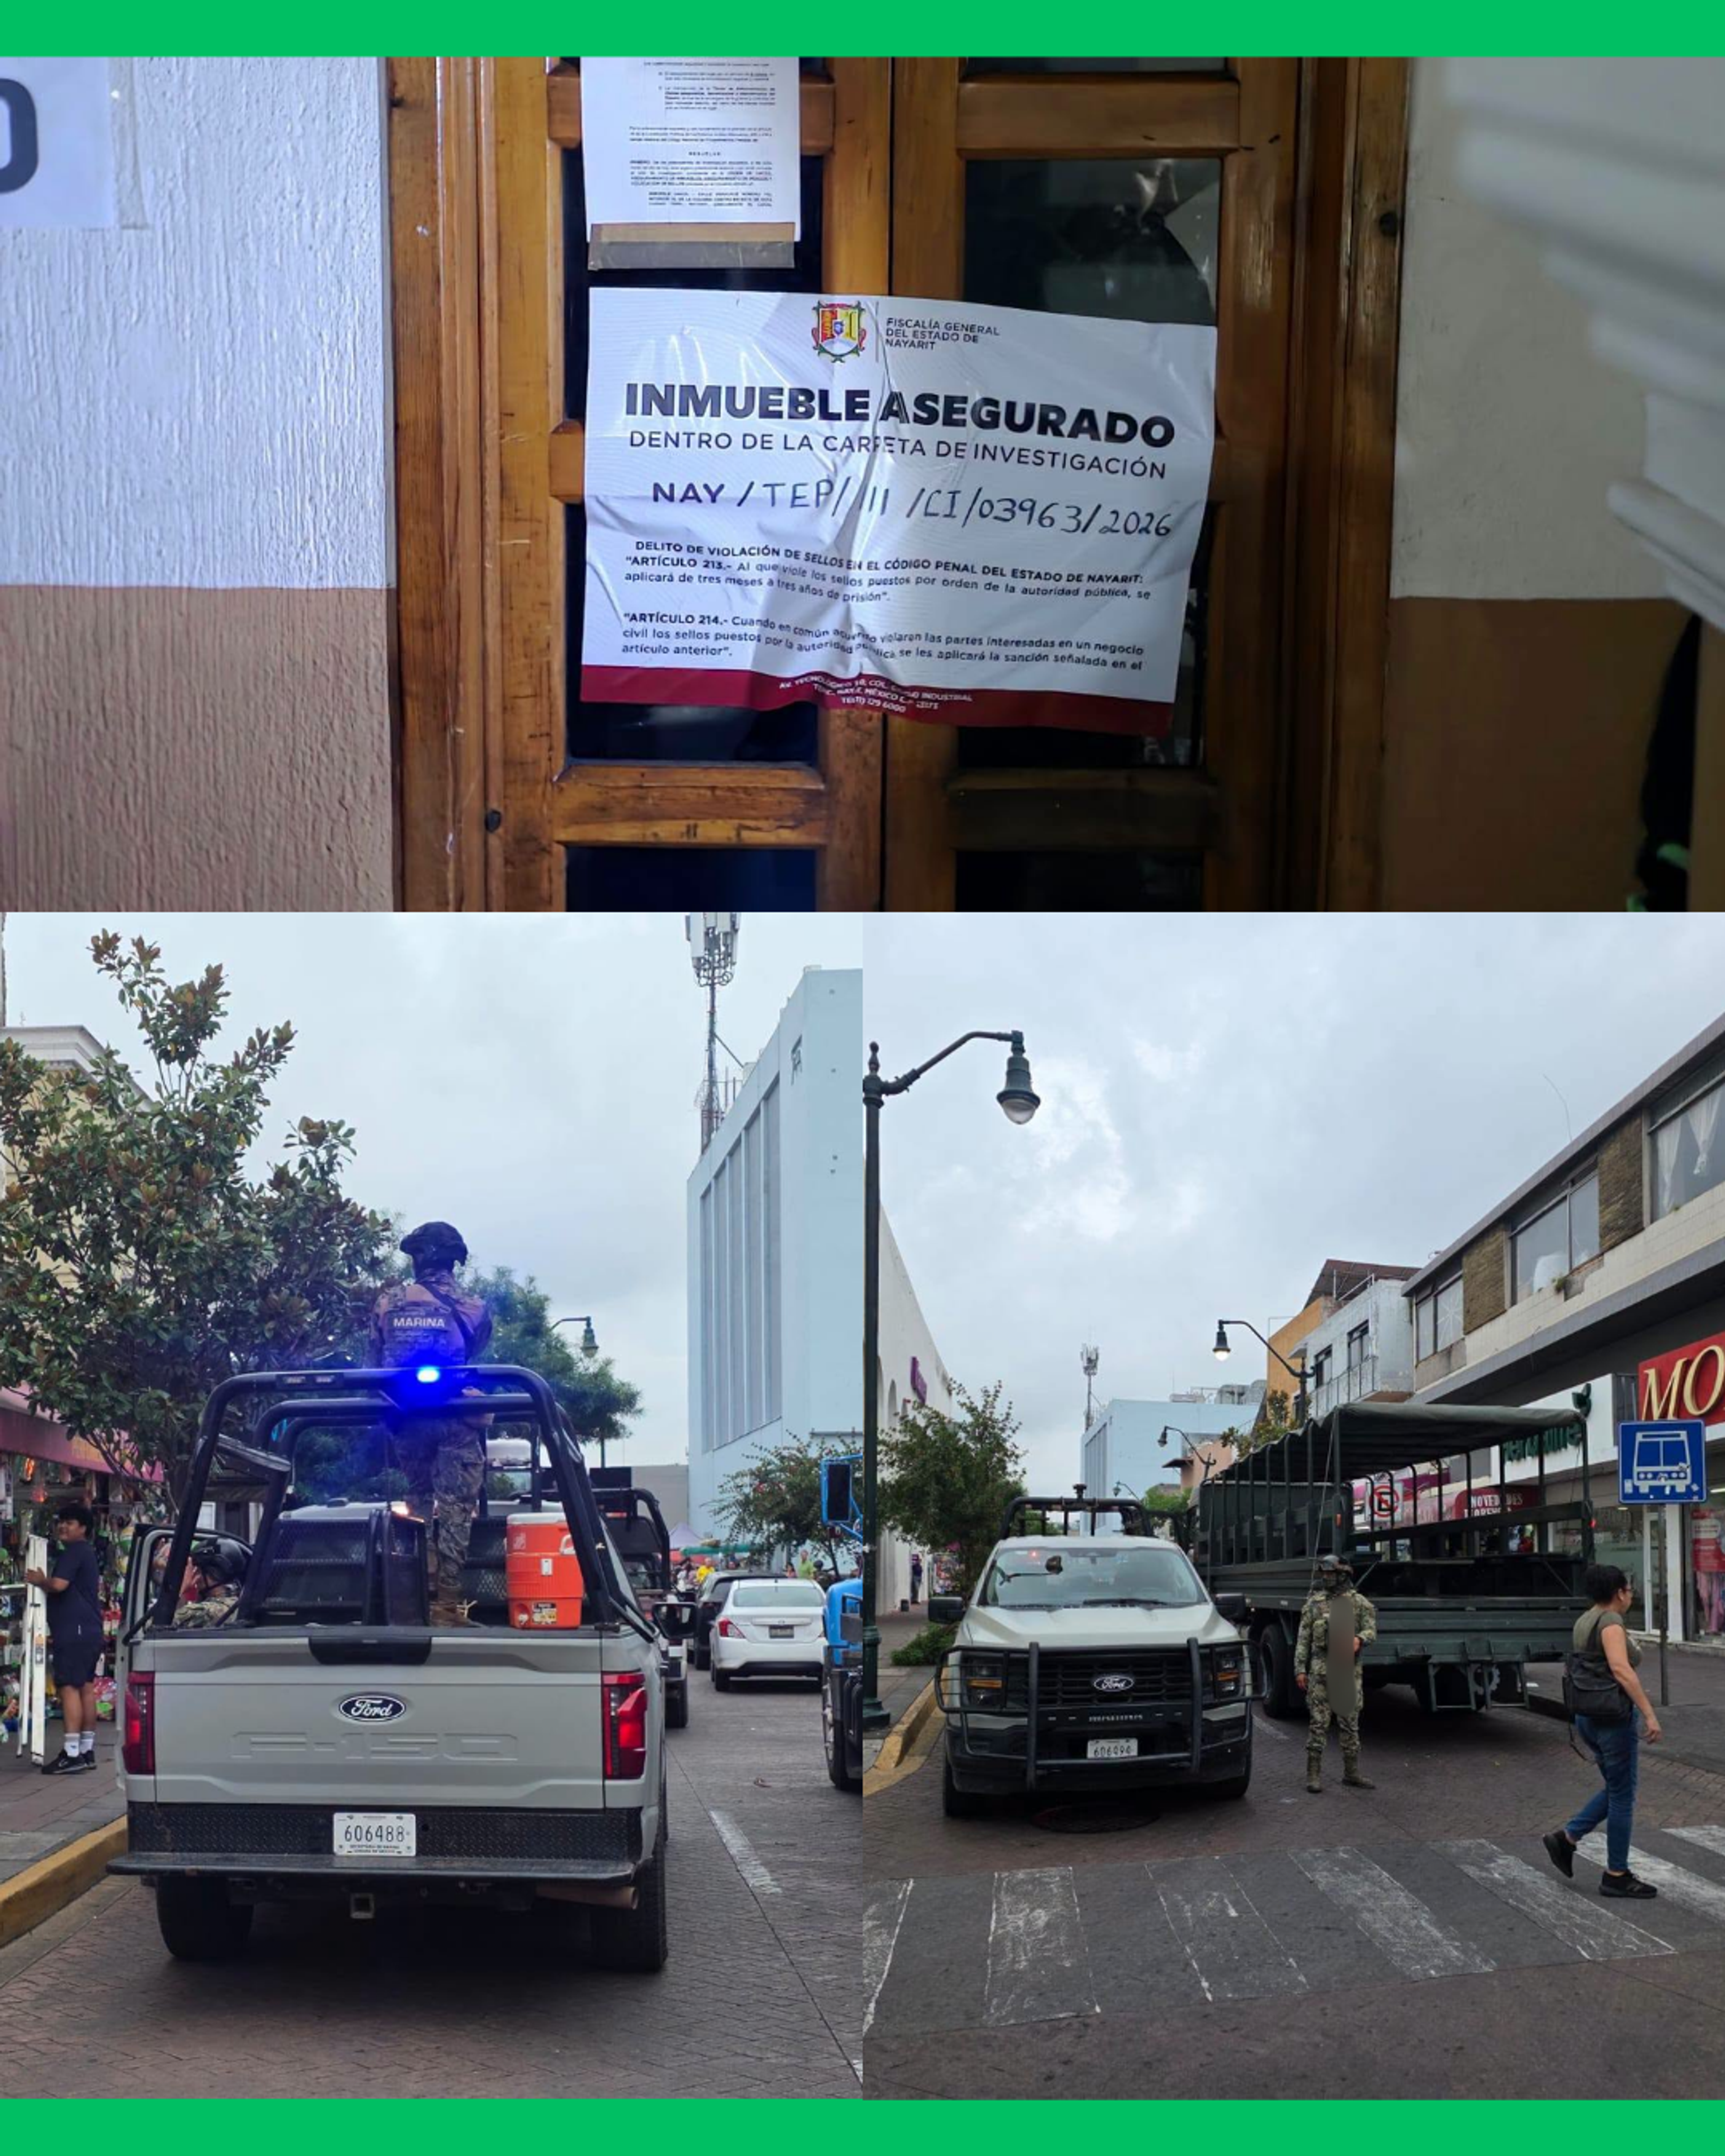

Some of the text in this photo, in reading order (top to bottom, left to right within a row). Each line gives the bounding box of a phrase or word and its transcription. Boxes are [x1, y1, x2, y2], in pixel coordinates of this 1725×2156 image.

[886, 318, 1000, 336] FISCALÍA GENERAL
[886, 328, 979, 343] DEL ESTADO DE
[885, 339, 936, 350] NAYARIT
[625, 383, 1176, 448] INMUEBLE ASEGURADO
[630, 431, 1166, 479] DENTRO DE LA CARPETA DE INVESTIGACIÓN
[636, 541, 1143, 584] DELITO DE VIOLACIÓN DE SELLOS EN EL CÓDIGO PENAL DEL ESTADO DE NAYARIT:
[624, 572, 674, 584] aplicará
[678, 573, 694, 583] de
[698, 574, 722, 584] tres
[725, 577, 763, 587] meses
[766, 579, 774, 587] a
[778, 579, 796, 592] tres
[799, 583, 824, 597] años
[827, 590, 840, 600] de
[702, 560, 732, 571] 213.-
[737, 562, 751, 572] Al
[756, 563, 779, 574] que
[782, 565, 807, 578] viole
[811, 570, 827, 582] los
[831, 574, 863, 587] sellos
[868, 576, 911, 588] puestos
[915, 576, 937, 586] por
[942, 579, 979, 590] orden
[984, 581, 1000, 592] de
[1004, 583, 1016, 594] la
[1021, 586, 1080, 597] autoridad
[1084, 588, 1132, 599] pública,
[1137, 590, 1151, 600] se
[698, 614, 729, 625] 214.-
[731, 616, 776, 630] Cuando
[778, 623, 792, 633] en
[793, 626, 830, 639] común
[880, 632, 922, 643] violaran
[924, 632, 942, 644] las
[945, 634, 984, 647] partes
[986, 636, 1055, 649] interesadas
[1058, 639, 1073, 649] en
[1075, 641, 1092, 650] un
[1093, 643, 1145, 656] negocio
[621, 643, 670, 654] artículo
[622, 628, 648, 639] civil
[652, 629, 671, 640] los
[674, 630, 711, 641] sellos
[714, 632, 762, 645] puestos
[765, 636, 783, 648] por
[785, 637, 795, 650] la
[796, 641, 854, 655] autoridad
[898, 649, 912, 658] se
[915, 647, 933, 658] les
[937, 649, 986, 662] aplicará
[989, 651, 1000, 662] la
[1004, 652, 1049, 663] sanción
[1053, 654, 1108, 667] señalada
[1111, 659, 1127, 669] en
[1130, 660, 1142, 671] el
[393, 1317, 445, 1328] MARINA
[1471, 1493, 1523, 1509] NOVEDDES
[351, 1699, 393, 1717] Ford
[345, 1825, 405, 1842] 606488
